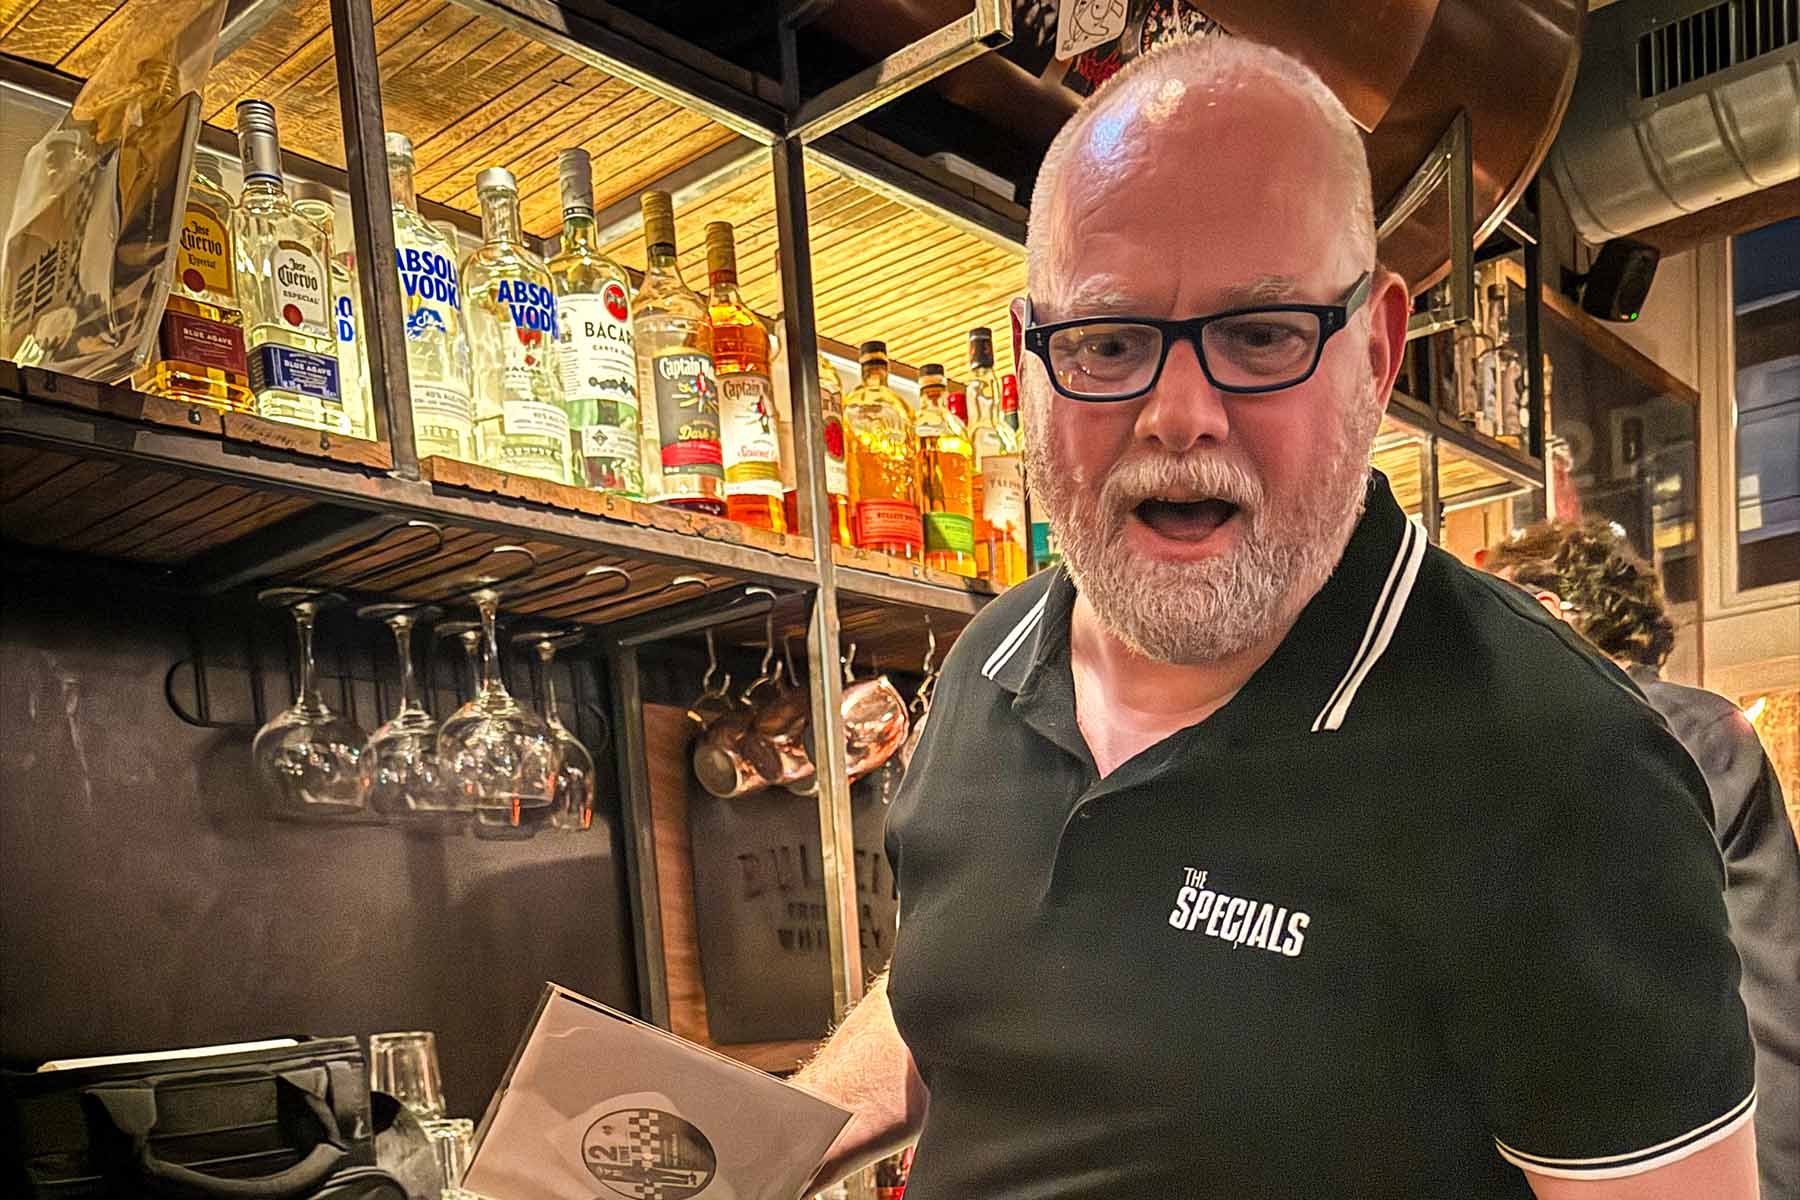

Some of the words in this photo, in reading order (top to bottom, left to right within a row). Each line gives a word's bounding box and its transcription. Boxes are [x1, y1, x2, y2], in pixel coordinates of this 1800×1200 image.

[180, 227, 222, 256] Cuervo
[278, 264, 318, 291] Cuervo
[282, 290, 320, 304] ESPECIAL
[498, 280, 555, 310] ABSO
[283, 359, 305, 371] BLUE
[305, 365, 332, 377] AGAVE
[659, 356, 701, 380] Captain
[1183, 867, 1208, 889] THE
[1168, 886, 1311, 957] SPECIALS
